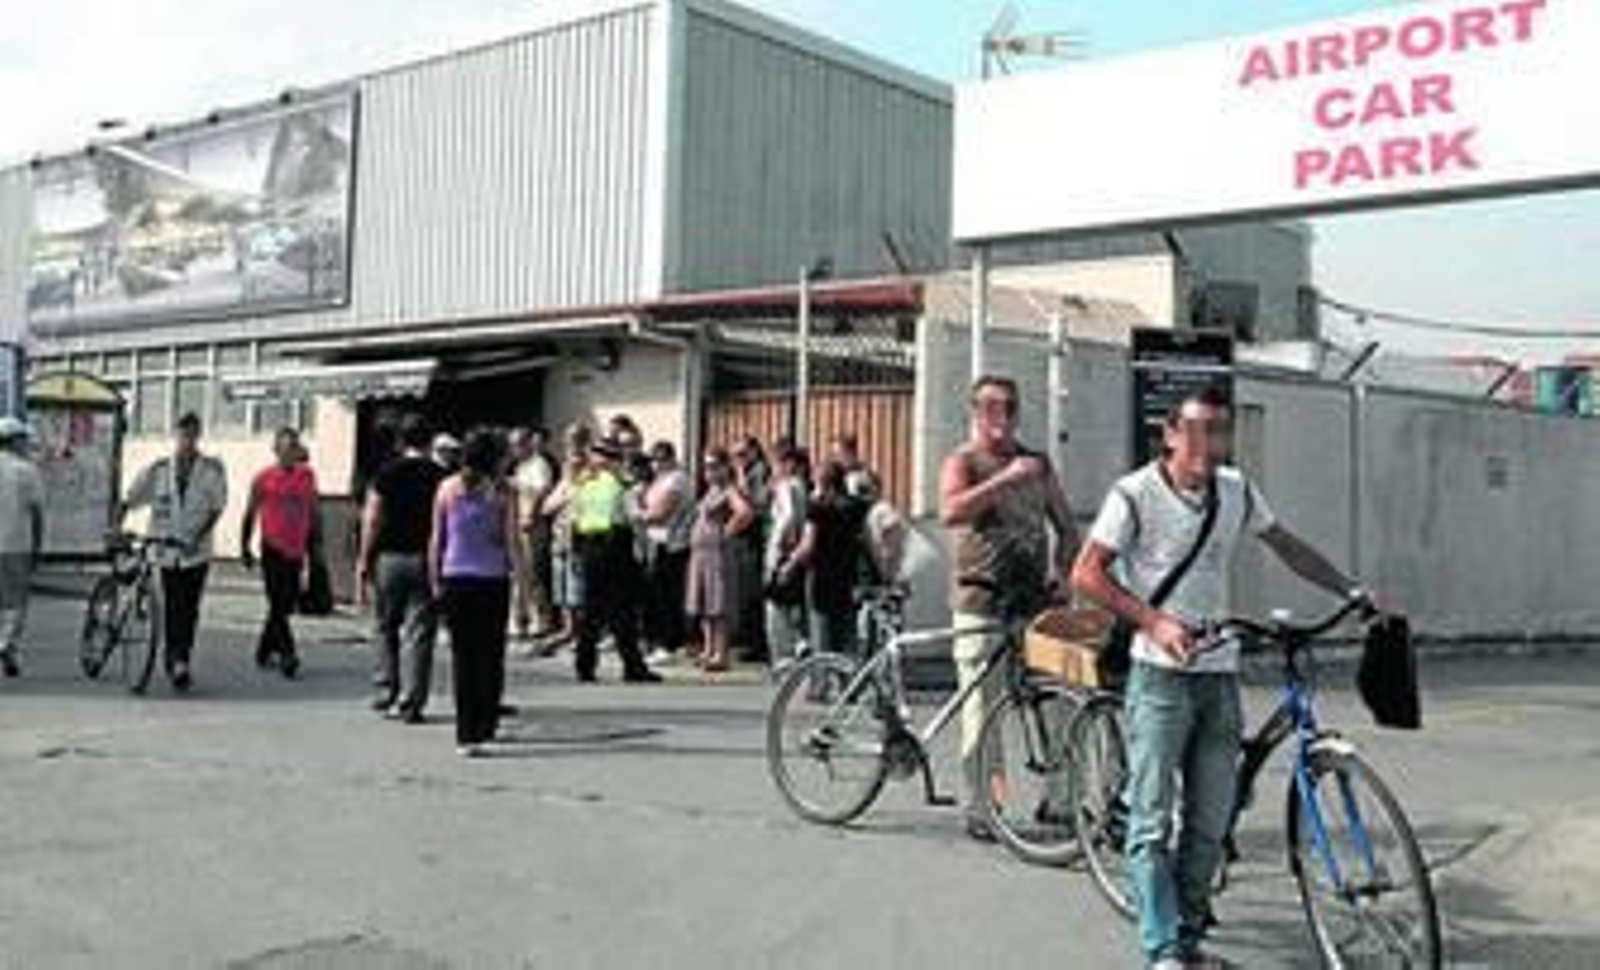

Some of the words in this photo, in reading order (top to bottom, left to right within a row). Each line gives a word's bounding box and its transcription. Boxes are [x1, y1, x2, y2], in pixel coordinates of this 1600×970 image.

[1238, 0, 1547, 85] AIRPORT
[1314, 75, 1455, 129] CAR
[1294, 128, 1479, 189] PARK
